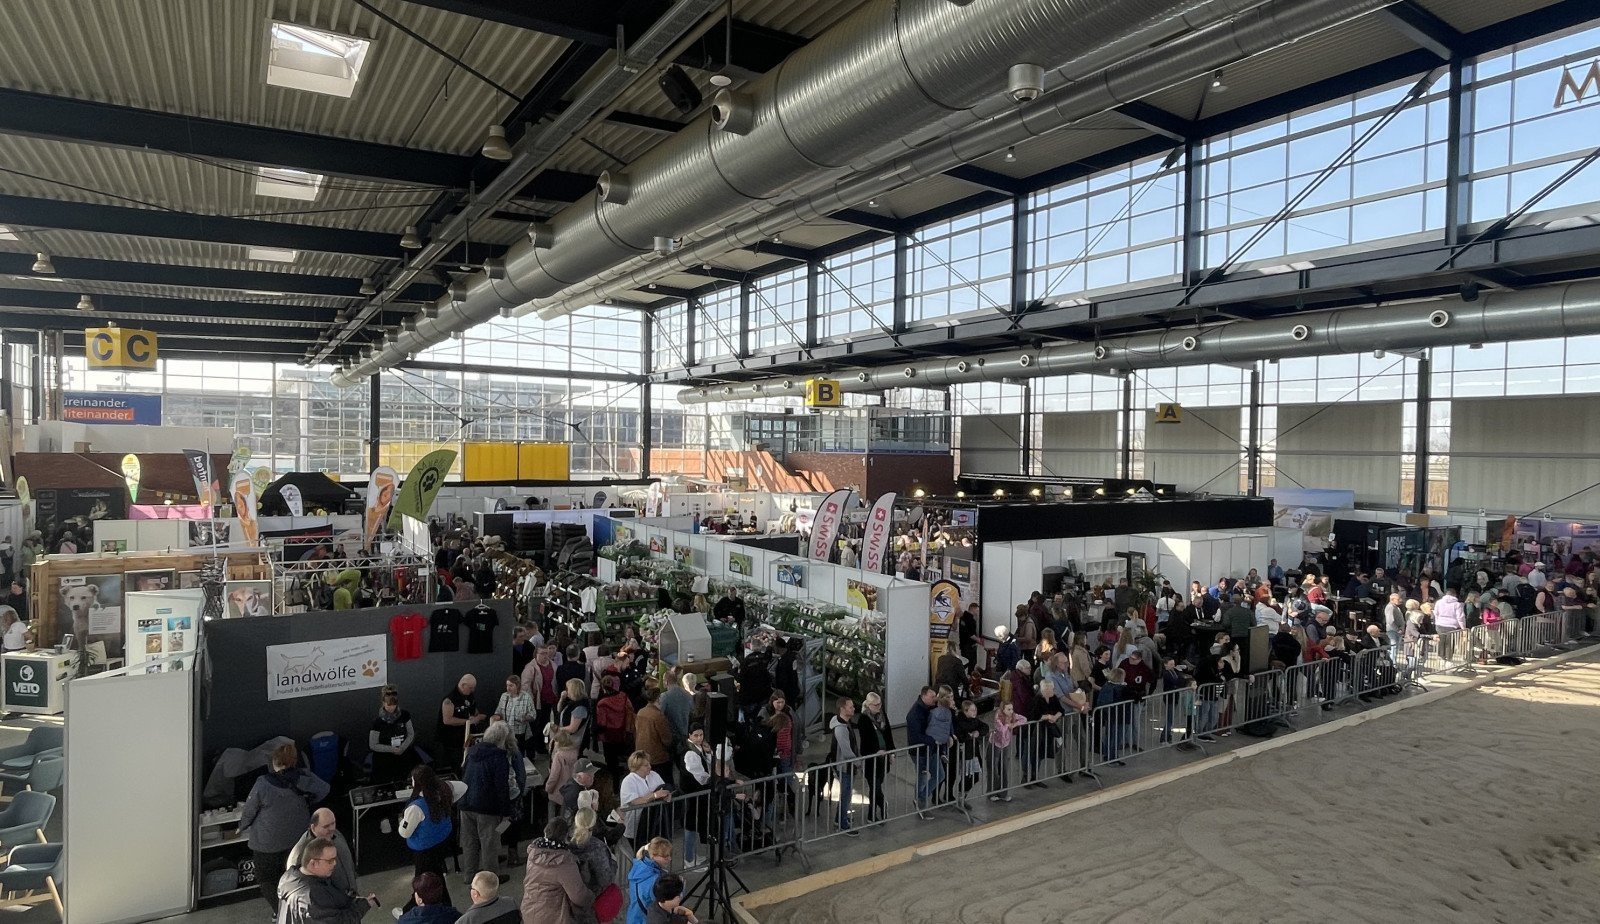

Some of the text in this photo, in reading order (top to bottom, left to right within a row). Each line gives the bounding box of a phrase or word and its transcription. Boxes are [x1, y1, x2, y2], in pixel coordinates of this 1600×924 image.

[92, 333, 113, 361] C
[127, 335, 150, 362] C
[819, 384, 833, 401] B
[1164, 404, 1177, 418] A
[815, 515, 834, 557] SWISS
[867, 522, 884, 570] SWISS
[12, 681, 40, 694] VETO
[277, 665, 356, 686] landwölfe
